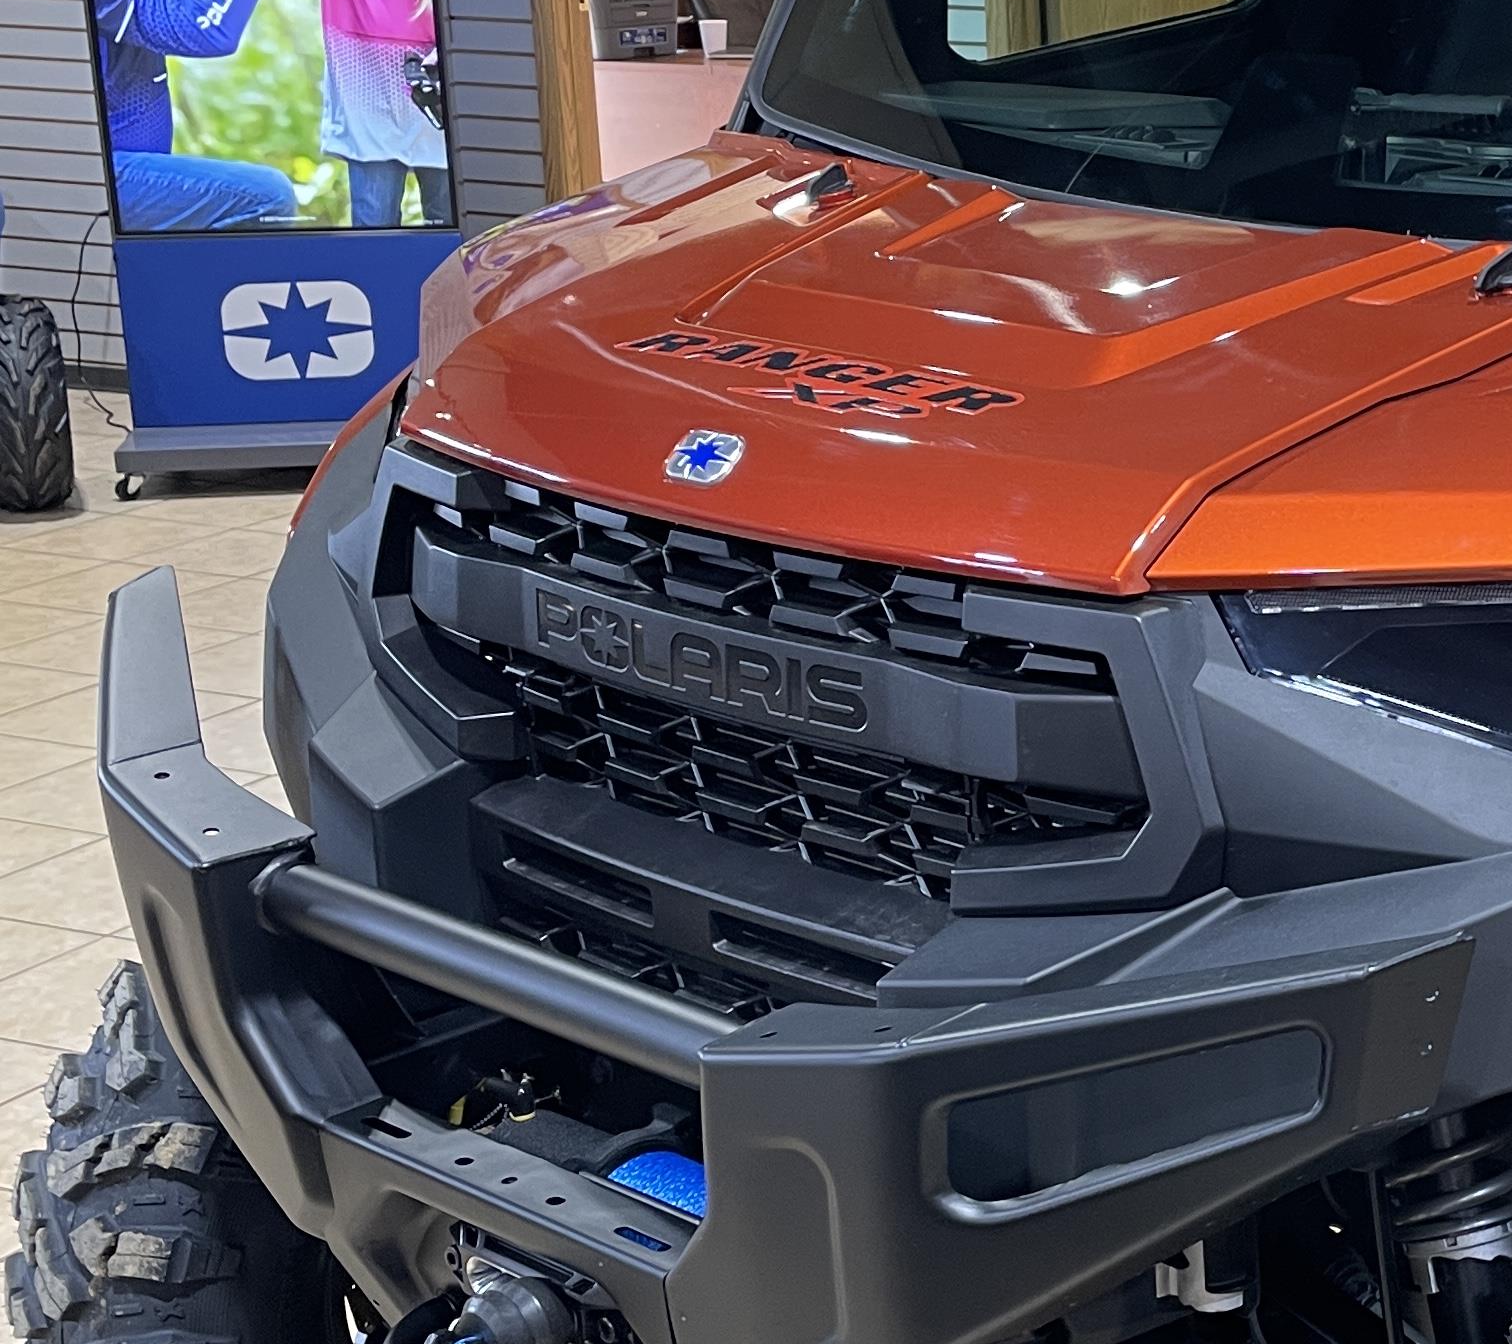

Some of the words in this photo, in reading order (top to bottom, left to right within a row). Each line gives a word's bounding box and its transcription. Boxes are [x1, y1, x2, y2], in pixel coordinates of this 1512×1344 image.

[617, 330, 1022, 414] RANGER
[730, 380, 930, 418] XP
[535, 587, 868, 734] POLARIS
